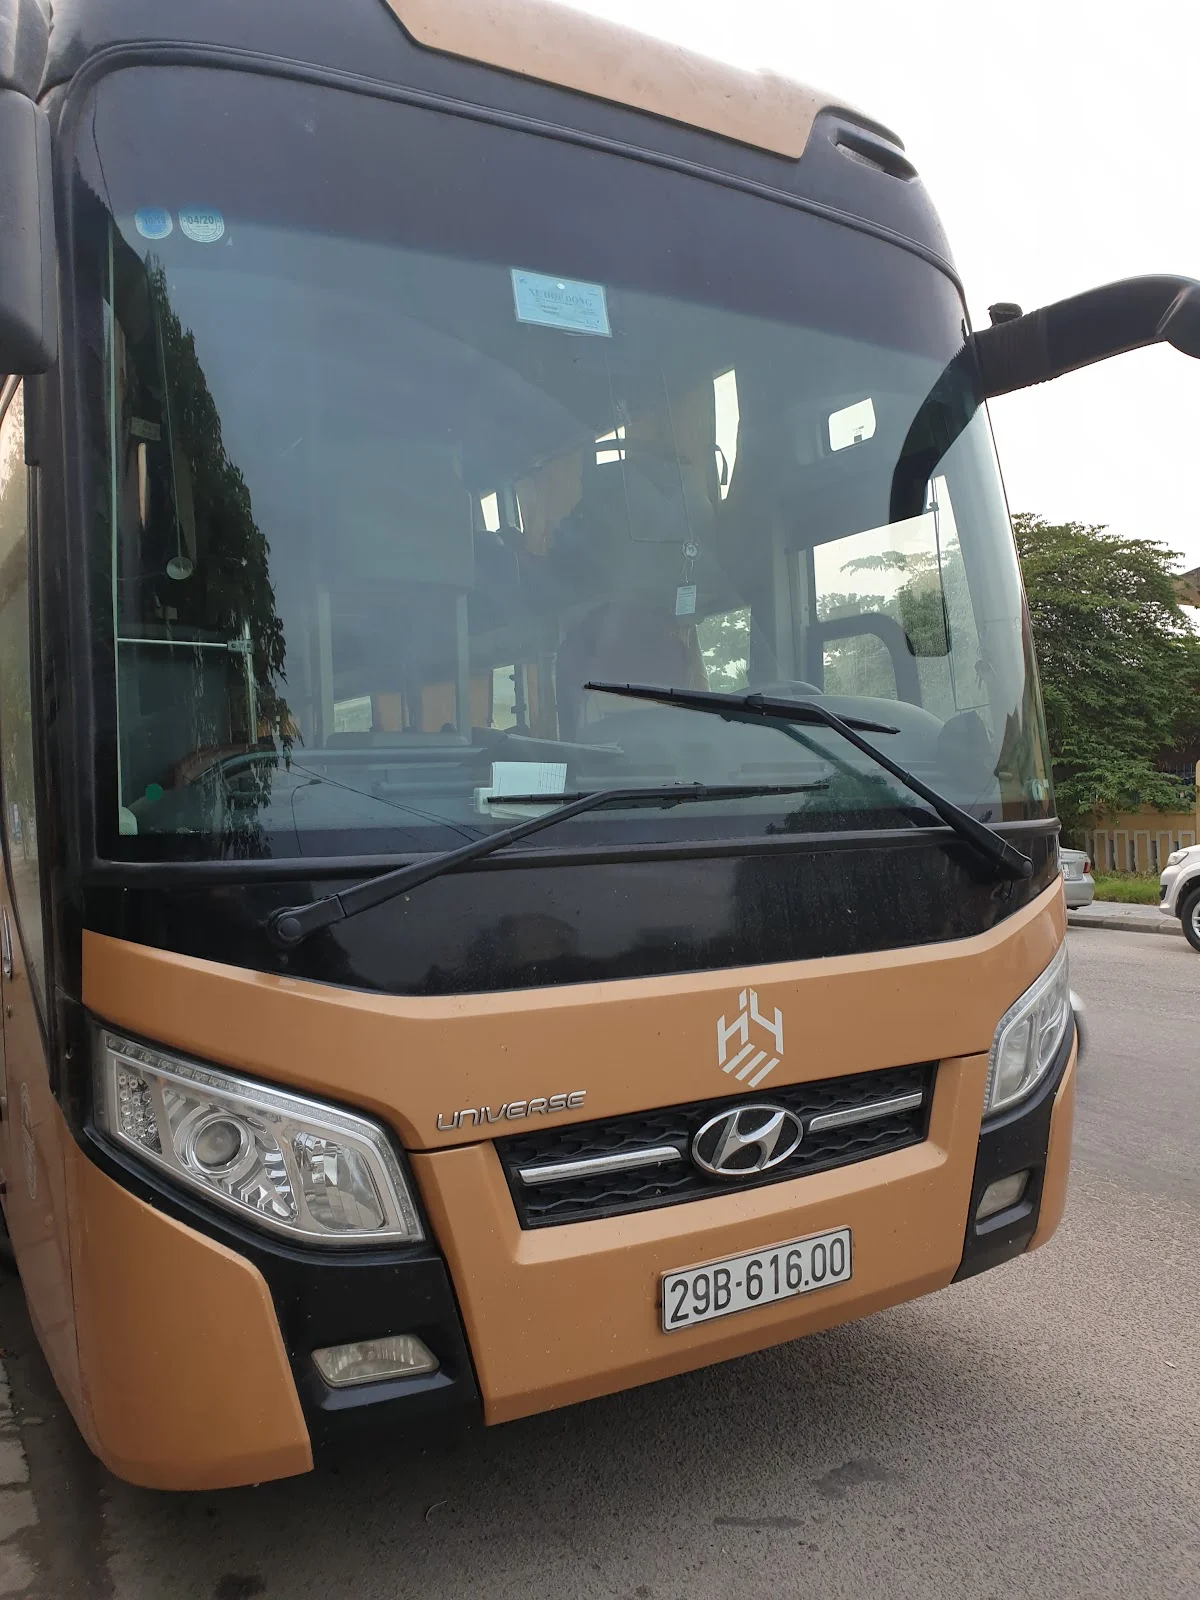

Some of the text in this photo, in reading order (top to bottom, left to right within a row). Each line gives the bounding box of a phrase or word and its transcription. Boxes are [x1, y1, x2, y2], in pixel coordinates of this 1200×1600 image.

[187, 215, 214, 225] 04/20
[437, 1090, 587, 1131] UNIVERSE
[670, 1237, 845, 1323] 29B-616.00
